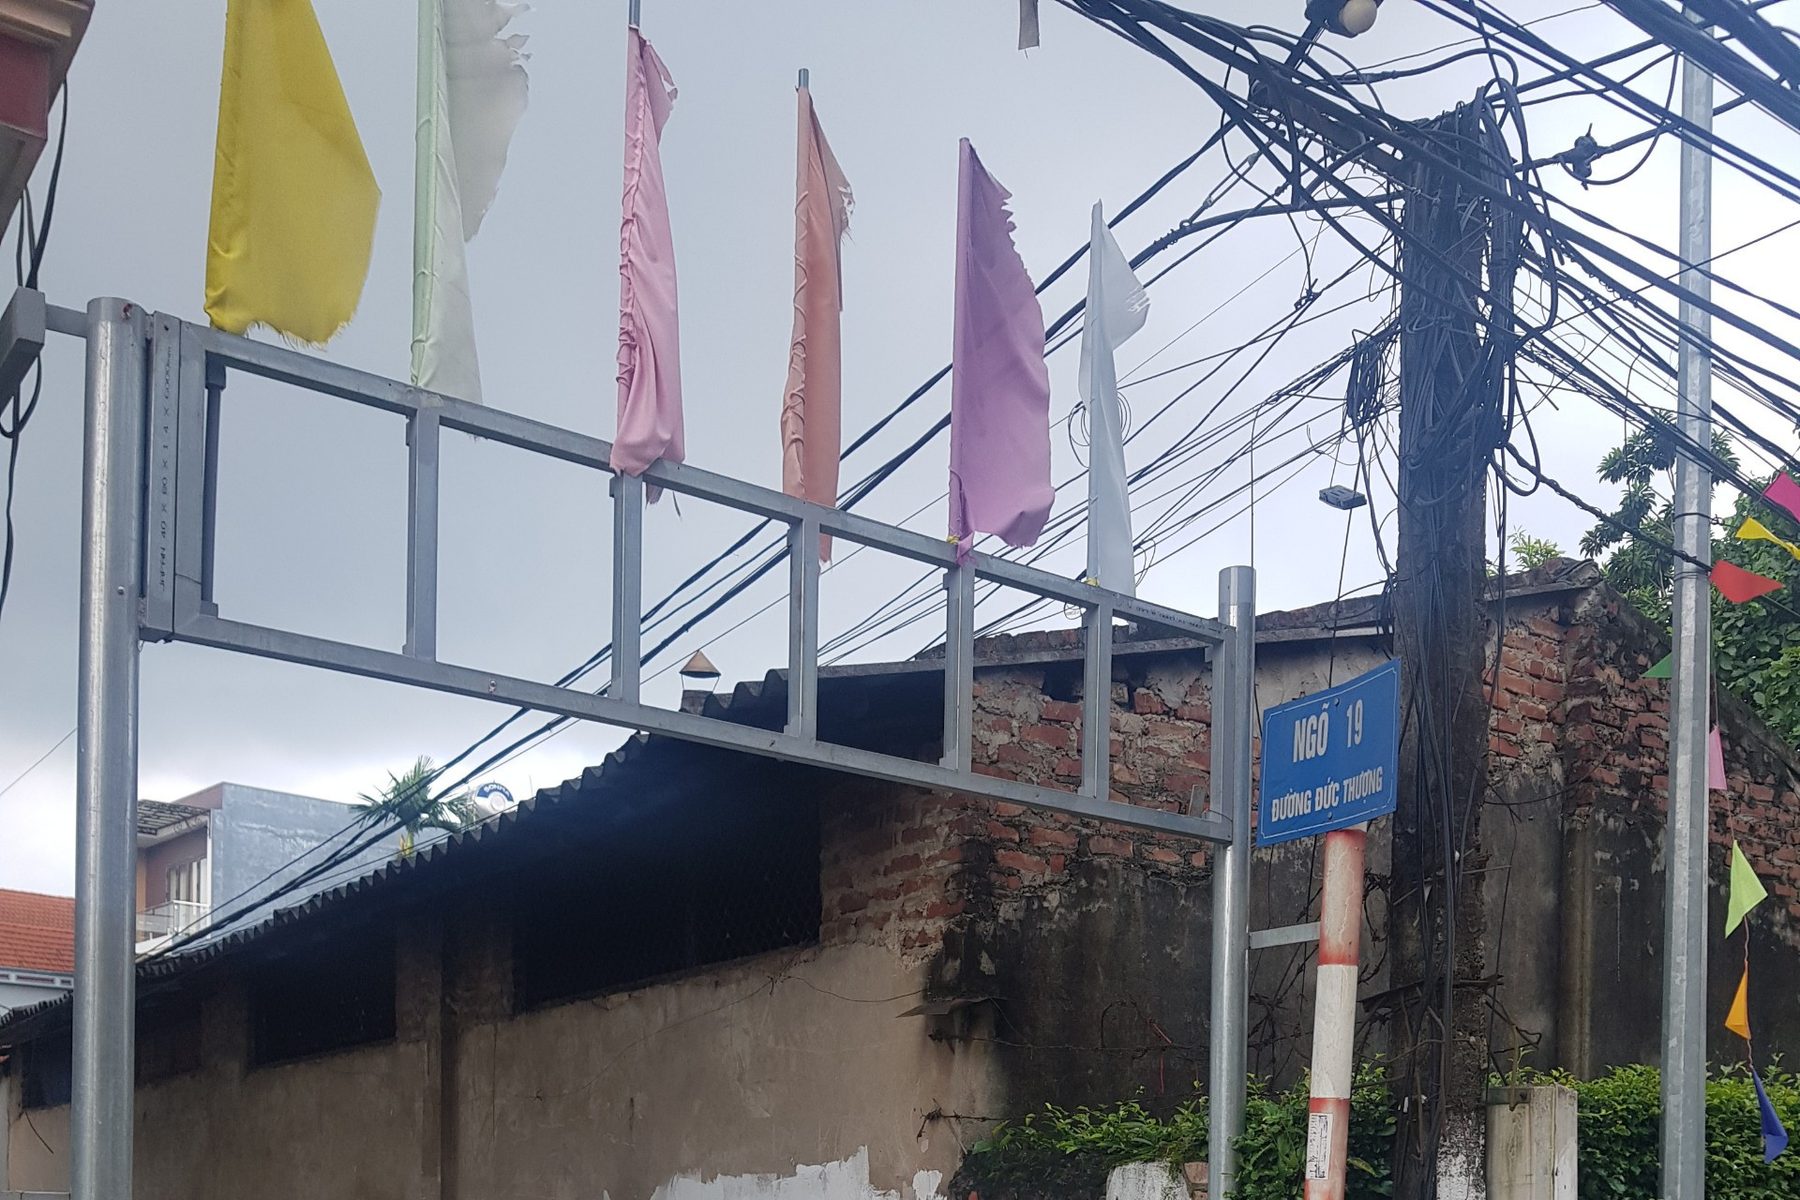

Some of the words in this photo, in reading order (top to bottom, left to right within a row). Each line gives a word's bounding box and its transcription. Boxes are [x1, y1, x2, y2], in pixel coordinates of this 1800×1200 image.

[1293, 702, 1330, 763] NGÕ
[1347, 699, 1363, 748] 19
[1271, 788, 1312, 822] ĐƯỜNG
[1314, 777, 1340, 812] ĐỨC
[1343, 766, 1383, 804] THƯỢNG
